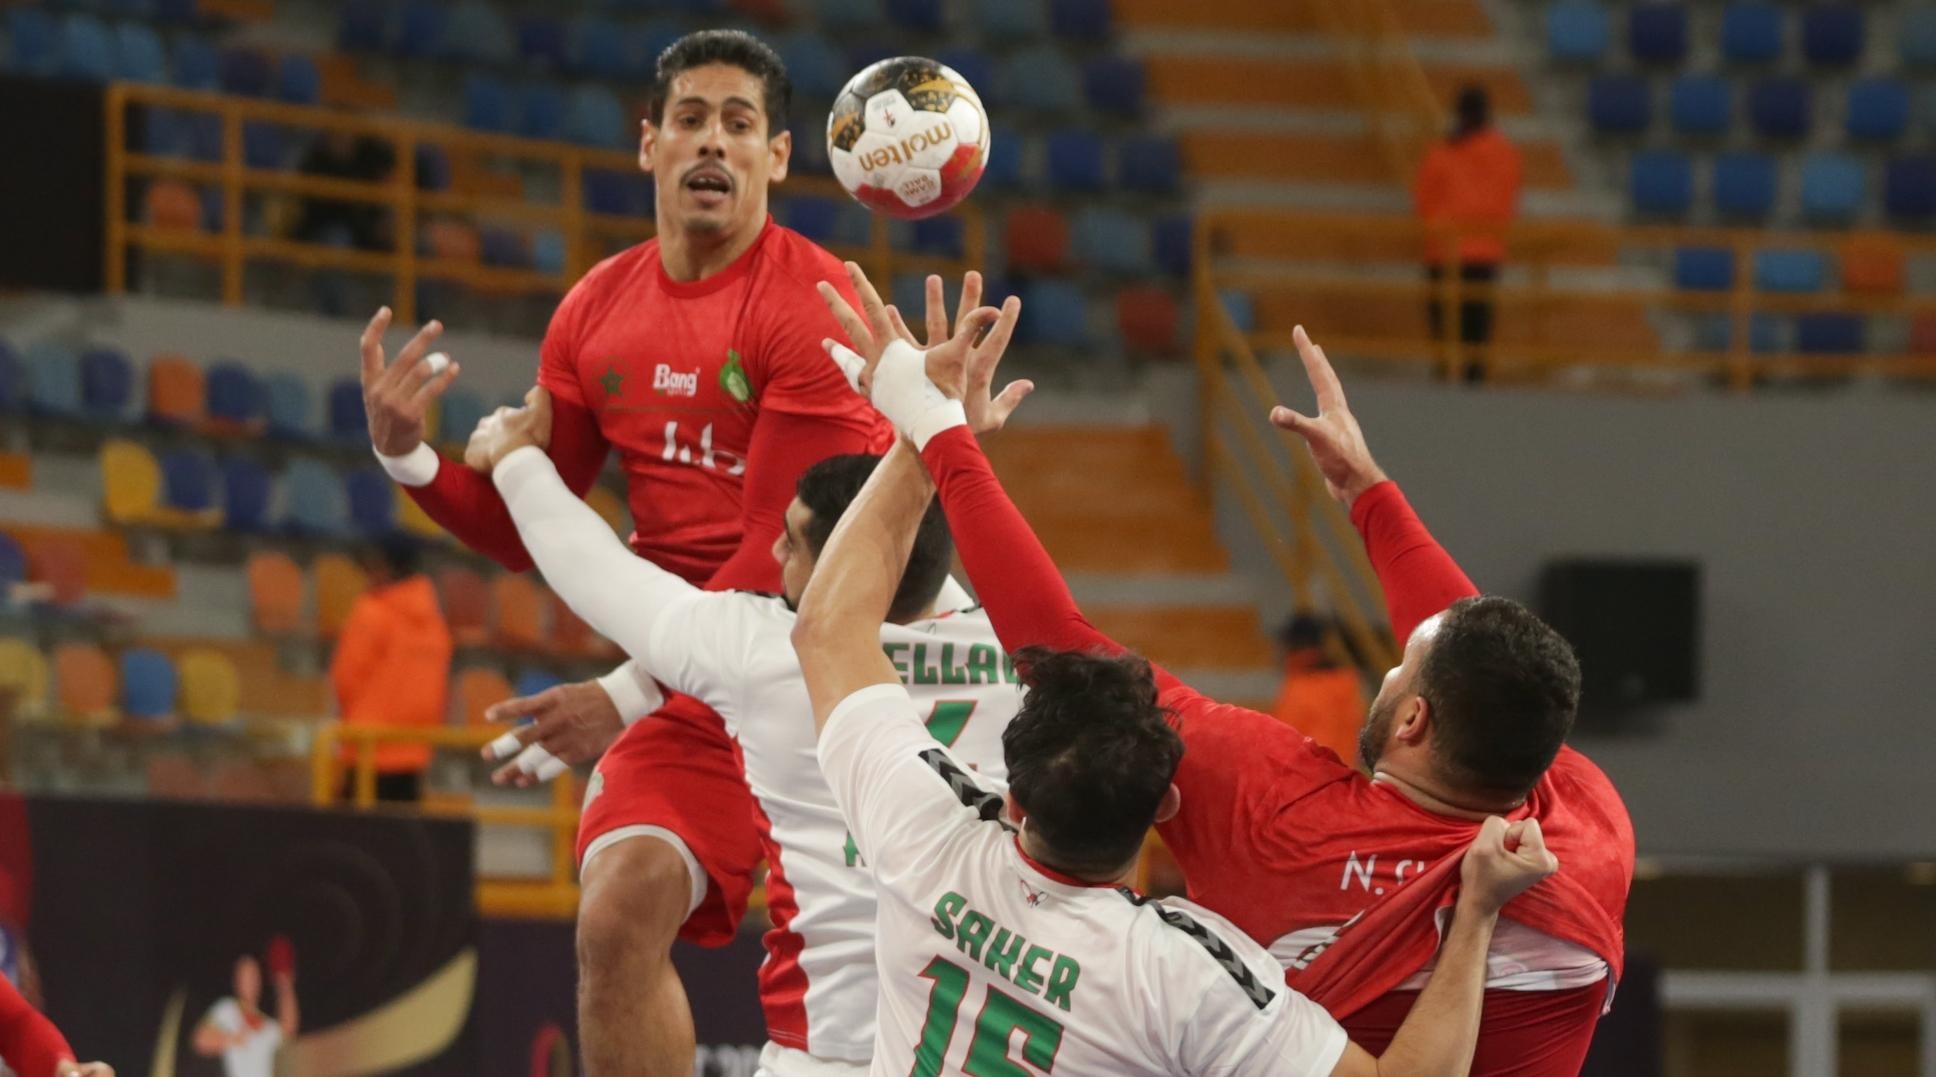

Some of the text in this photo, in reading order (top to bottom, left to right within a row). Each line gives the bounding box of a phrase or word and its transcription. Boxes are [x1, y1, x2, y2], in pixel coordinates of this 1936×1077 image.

[859, 122, 951, 172] molten
[653, 363, 699, 397] Bang
[882, 642, 1019, 684] ELLA
[930, 890, 1081, 1013] SAKER
